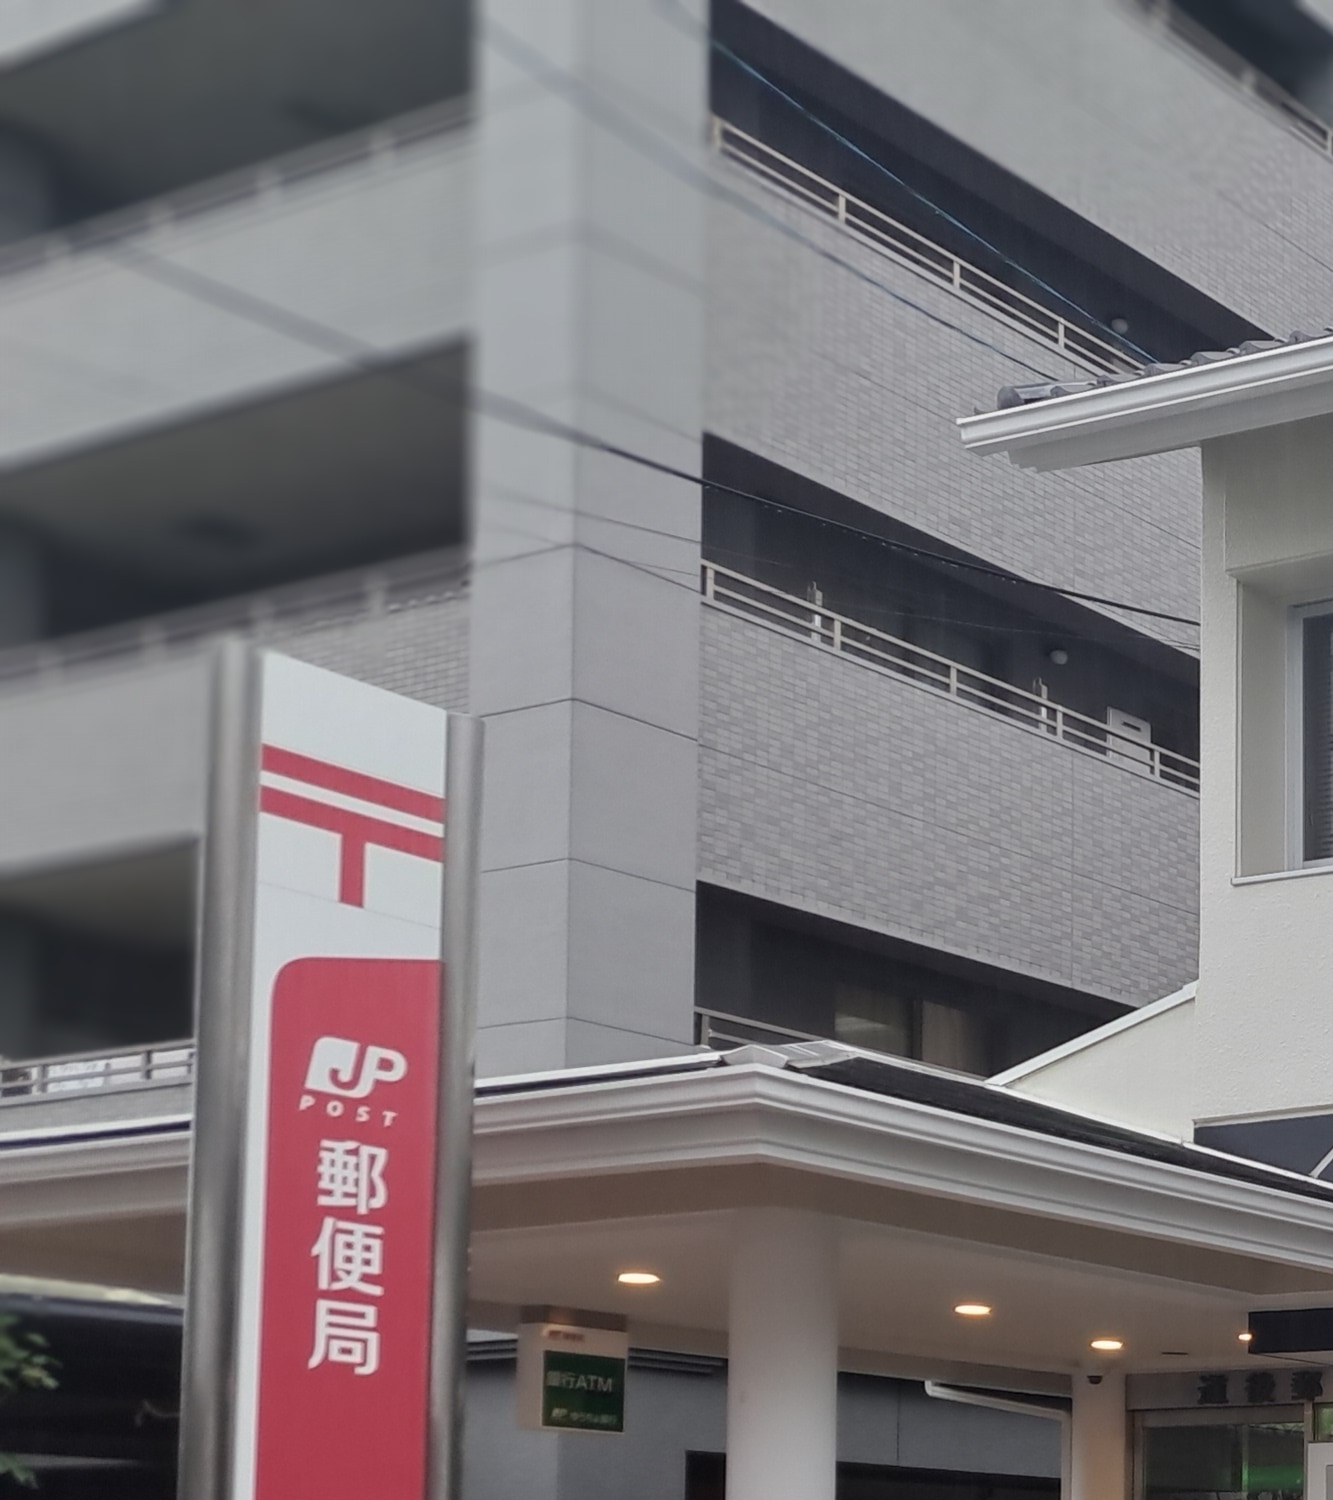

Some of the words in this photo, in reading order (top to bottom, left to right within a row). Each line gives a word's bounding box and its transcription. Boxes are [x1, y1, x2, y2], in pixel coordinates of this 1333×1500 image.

[303, 1036, 408, 1099] JP
[298, 1094, 399, 1127] POST
[307, 1138, 390, 1376] 郵便局
